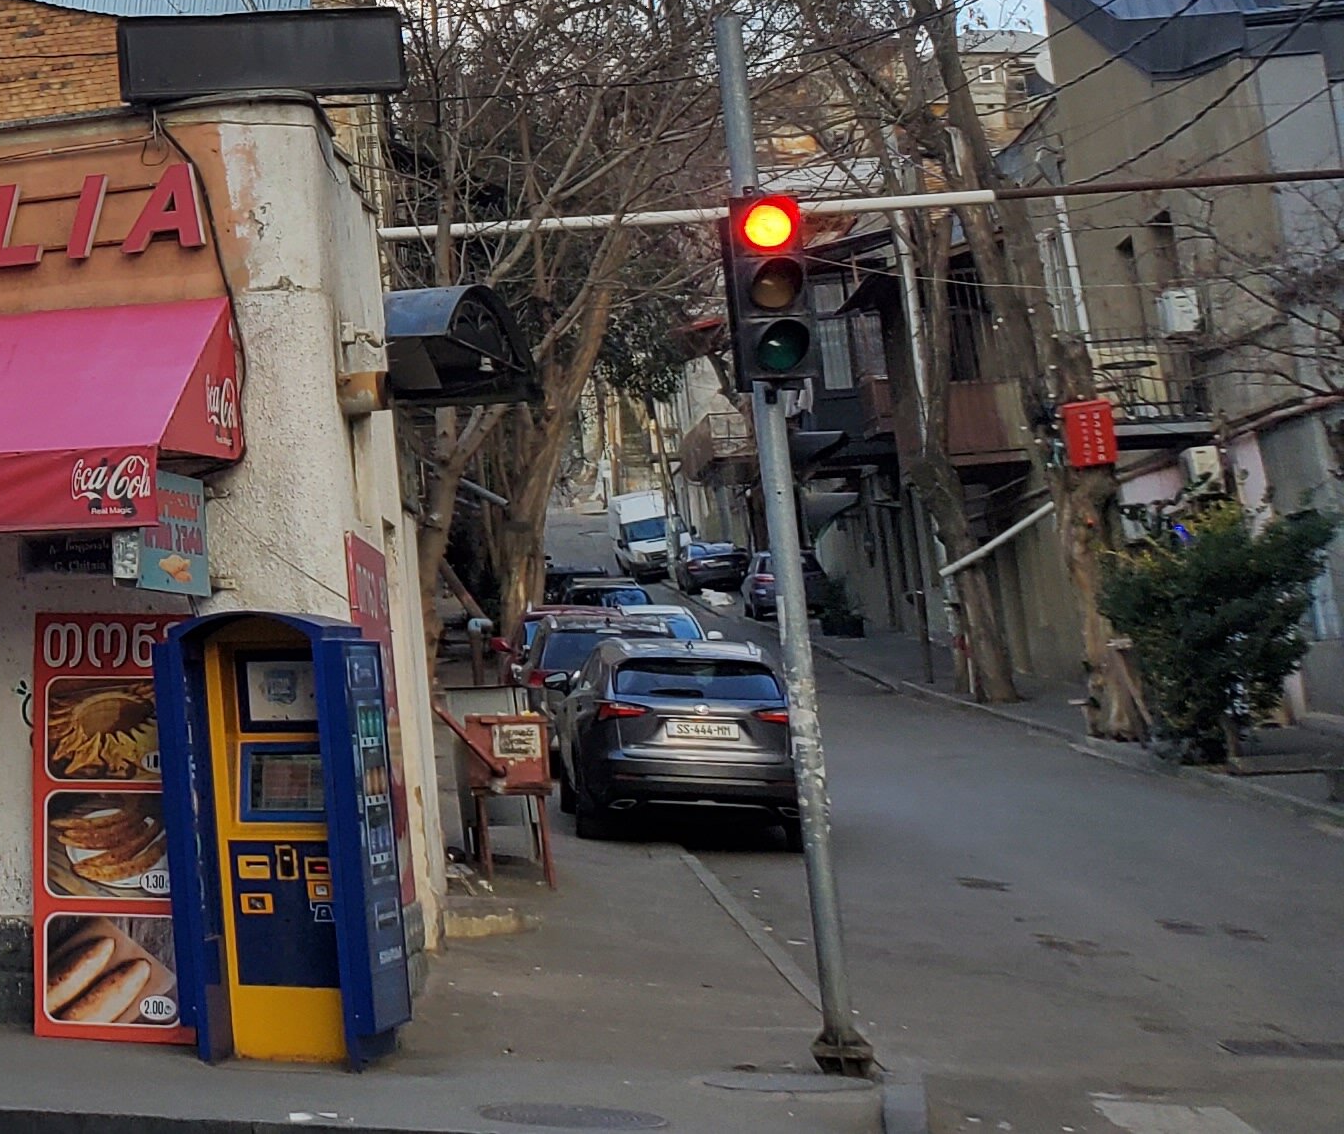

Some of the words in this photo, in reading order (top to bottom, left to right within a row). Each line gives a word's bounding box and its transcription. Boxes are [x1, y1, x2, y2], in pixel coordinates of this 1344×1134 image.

[91, 507, 108, 515] Real
[109, 506, 133, 515] Magic
[43, 622, 178, 669] თონ
[676, 724, 731, 736] SS-444-MM
